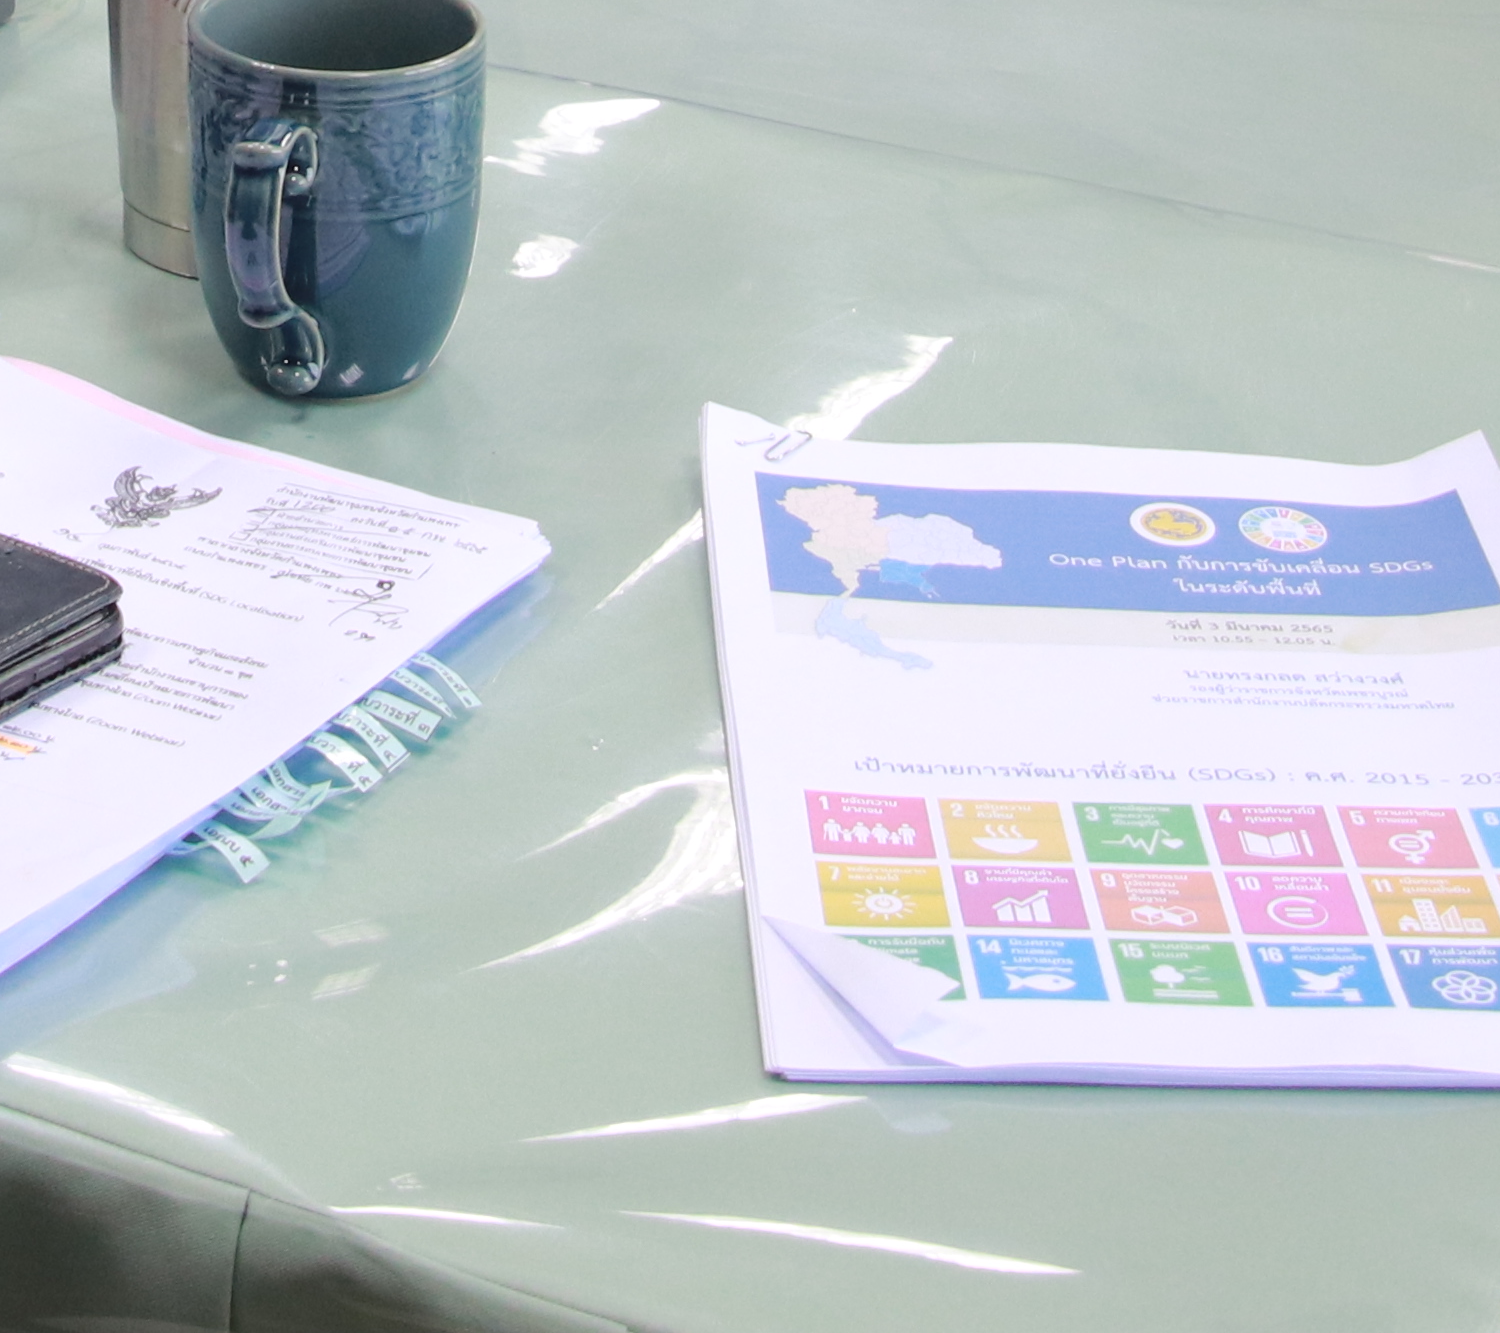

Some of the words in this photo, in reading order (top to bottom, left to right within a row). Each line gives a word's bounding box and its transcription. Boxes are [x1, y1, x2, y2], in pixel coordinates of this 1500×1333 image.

[1049, 553, 1102, 568] One
[1112, 555, 1167, 570] Plan
[1177, 555, 1360, 576] กับการขับเคลื่อน
[1369, 558, 1433, 575] SDGs
[1173, 577, 1322, 596] ในระดับพื้นที่
[200, 590, 232, 606] (SDG
[1166, 619, 1201, 631] วันที่
[1209, 622, 1219, 631] 3
[1227, 621, 1283, 633] มีนาคม
[1291, 624, 1333, 633] 2565
[1173, 634, 1206, 644] เวลา
[1314, 670, 1403, 685] สว่างวงศ์
[86, 715, 127, 732] (Zoom
[131, 726, 186, 748] Webinar)
[855, 755, 1175, 783] เป้าหมายการพัฒนาที่ยั่งยืน
[1188, 766, 1277, 784] (SDGs)
[1365, 770, 1430, 786] 2015
[819, 795, 831, 810] 1
[950, 803, 963, 817] 2
[1085, 806, 1100, 821] 3
[1219, 809, 1232, 824] 4
[1352, 811, 1364, 825] 5
[1484, 811, 1498, 825] 6
[829, 866, 840, 881] 7
[964, 870, 979, 884] 8
[1100, 873, 1116, 888] 9
[1235, 876, 1260, 891] 10
[1372, 879, 1391, 892] 11
[977, 940, 1000, 954] 14
[1118, 943, 1143, 958] 15
[1258, 948, 1283, 963] 16
[1401, 949, 1422, 964] 17
